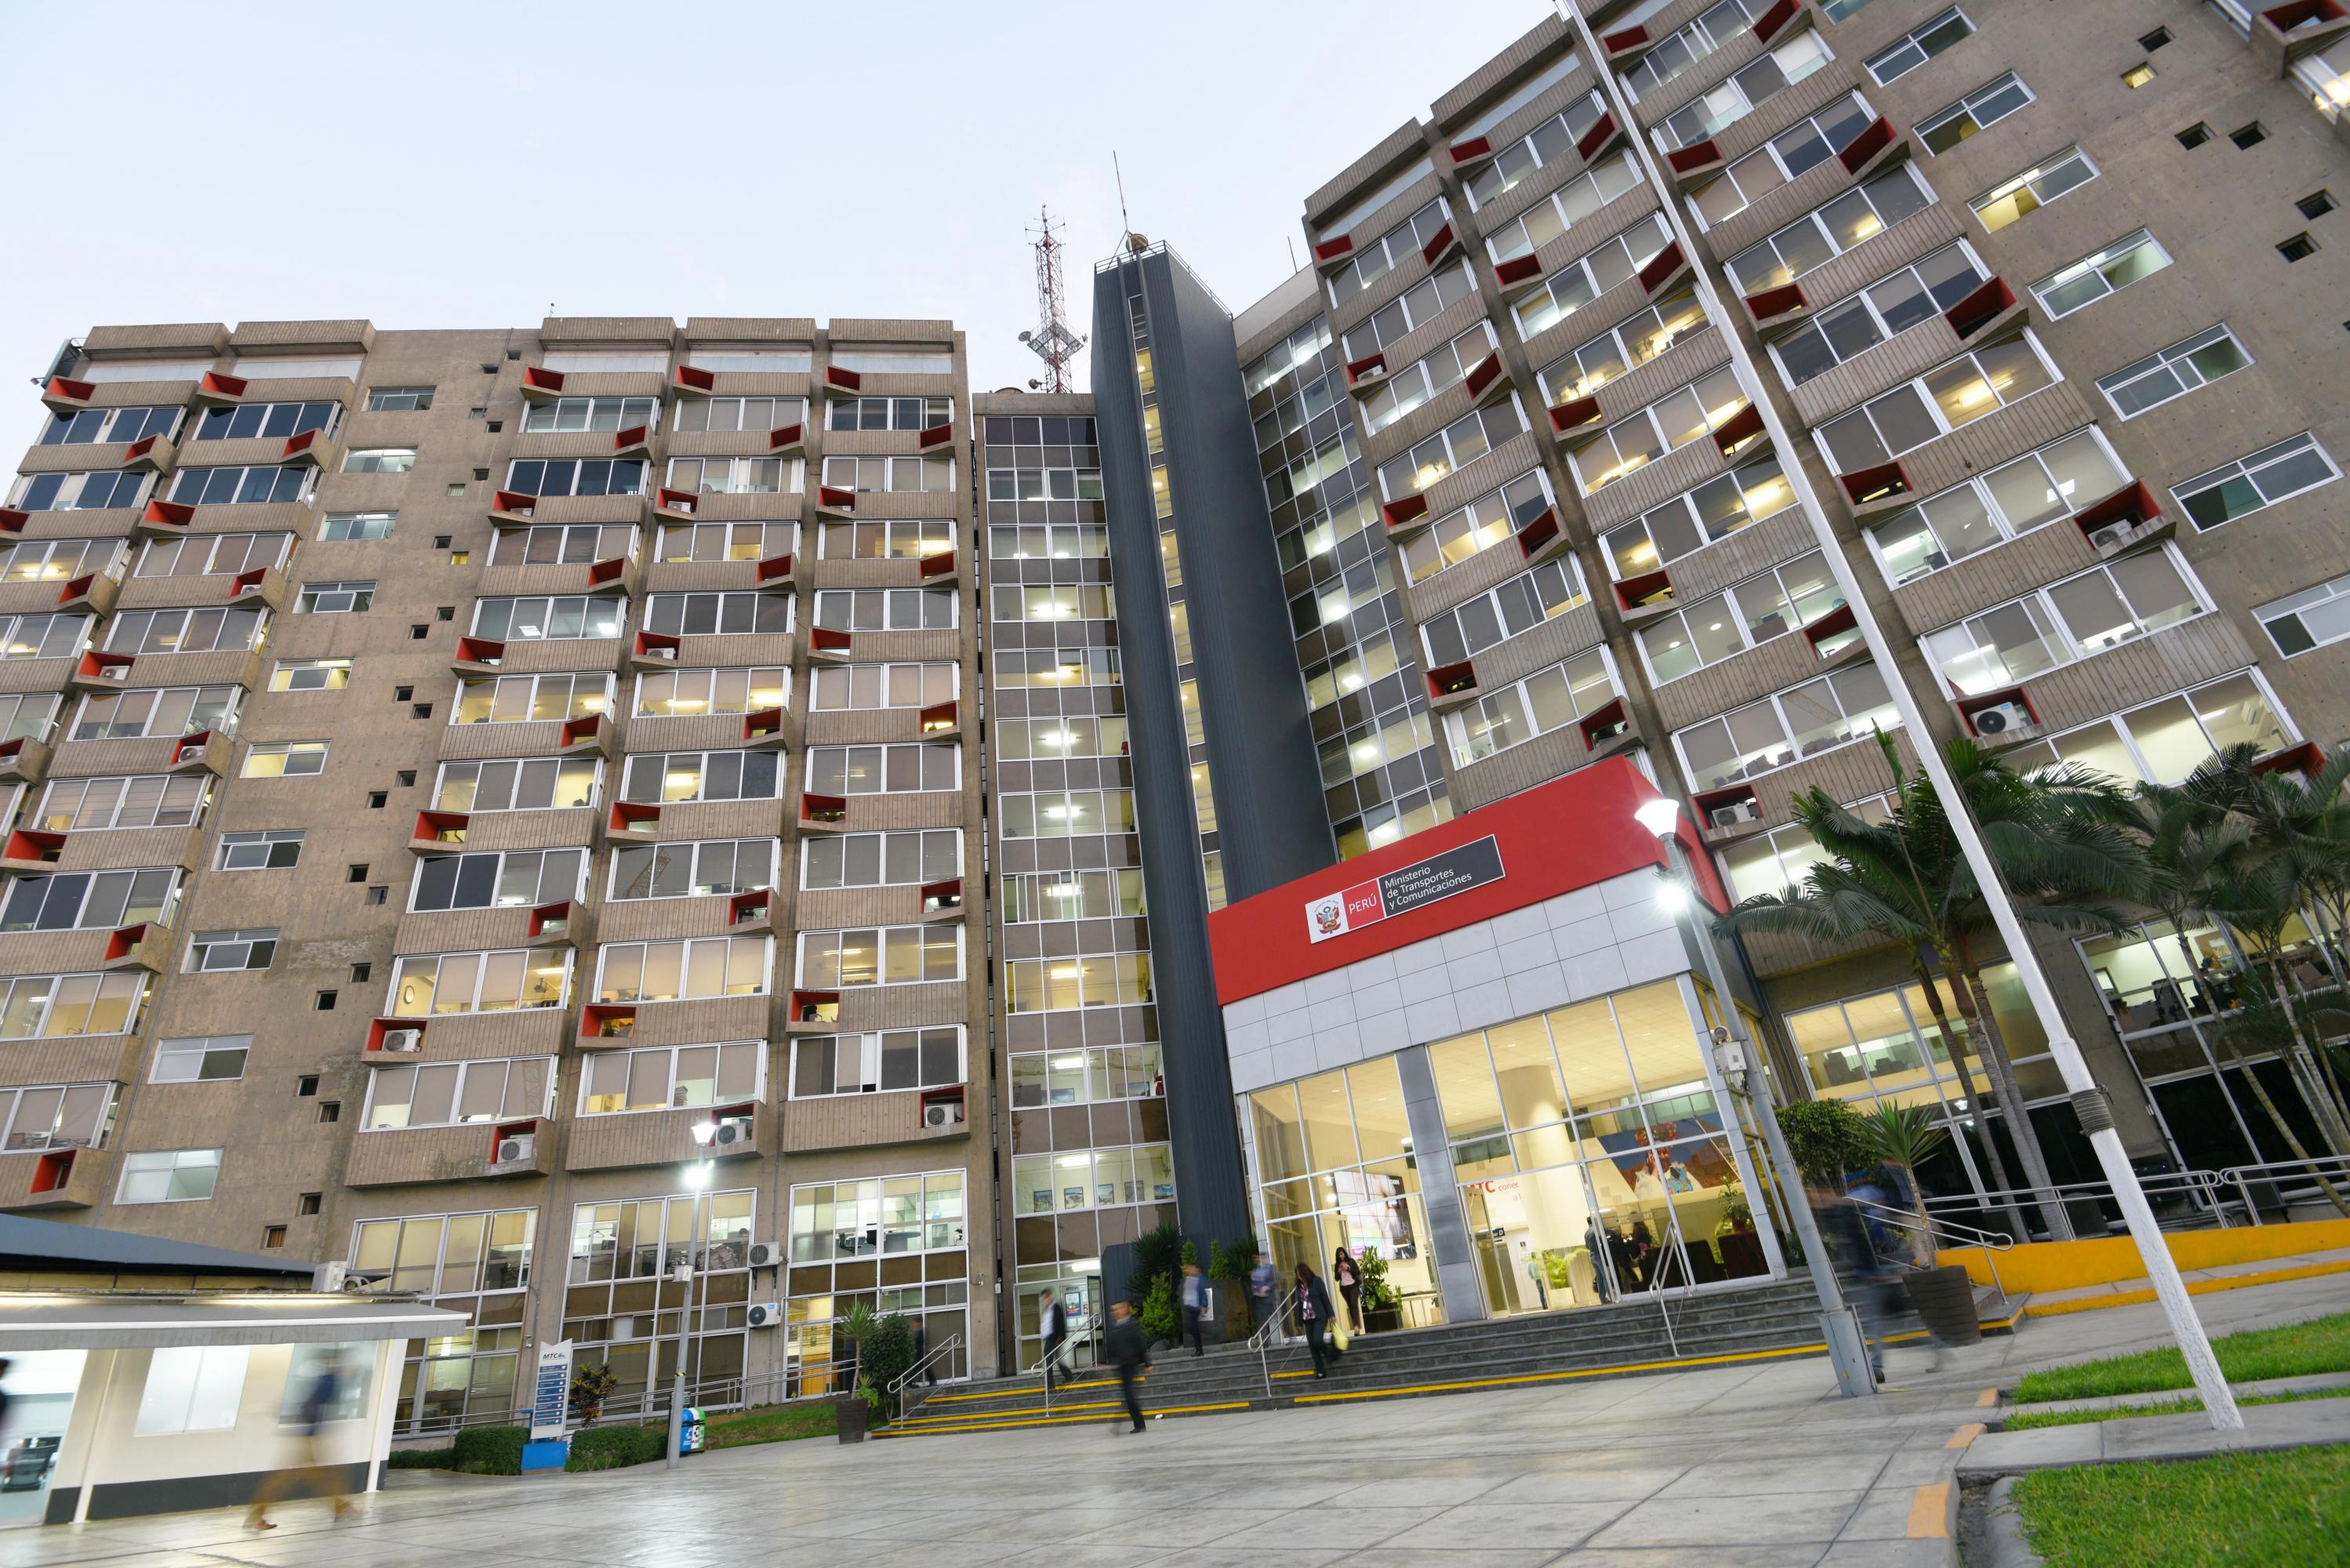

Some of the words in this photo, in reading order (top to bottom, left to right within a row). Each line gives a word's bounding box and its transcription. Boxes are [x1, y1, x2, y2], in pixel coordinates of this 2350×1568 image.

[1385, 866, 1431, 889] Ministerio
[1387, 888, 1399, 898] de
[1400, 869, 1455, 894] Transportes
[1349, 892, 1378, 915] PERÚ
[1389, 900, 1395, 910] y
[1397, 873, 1473, 906] Comunicaciones
